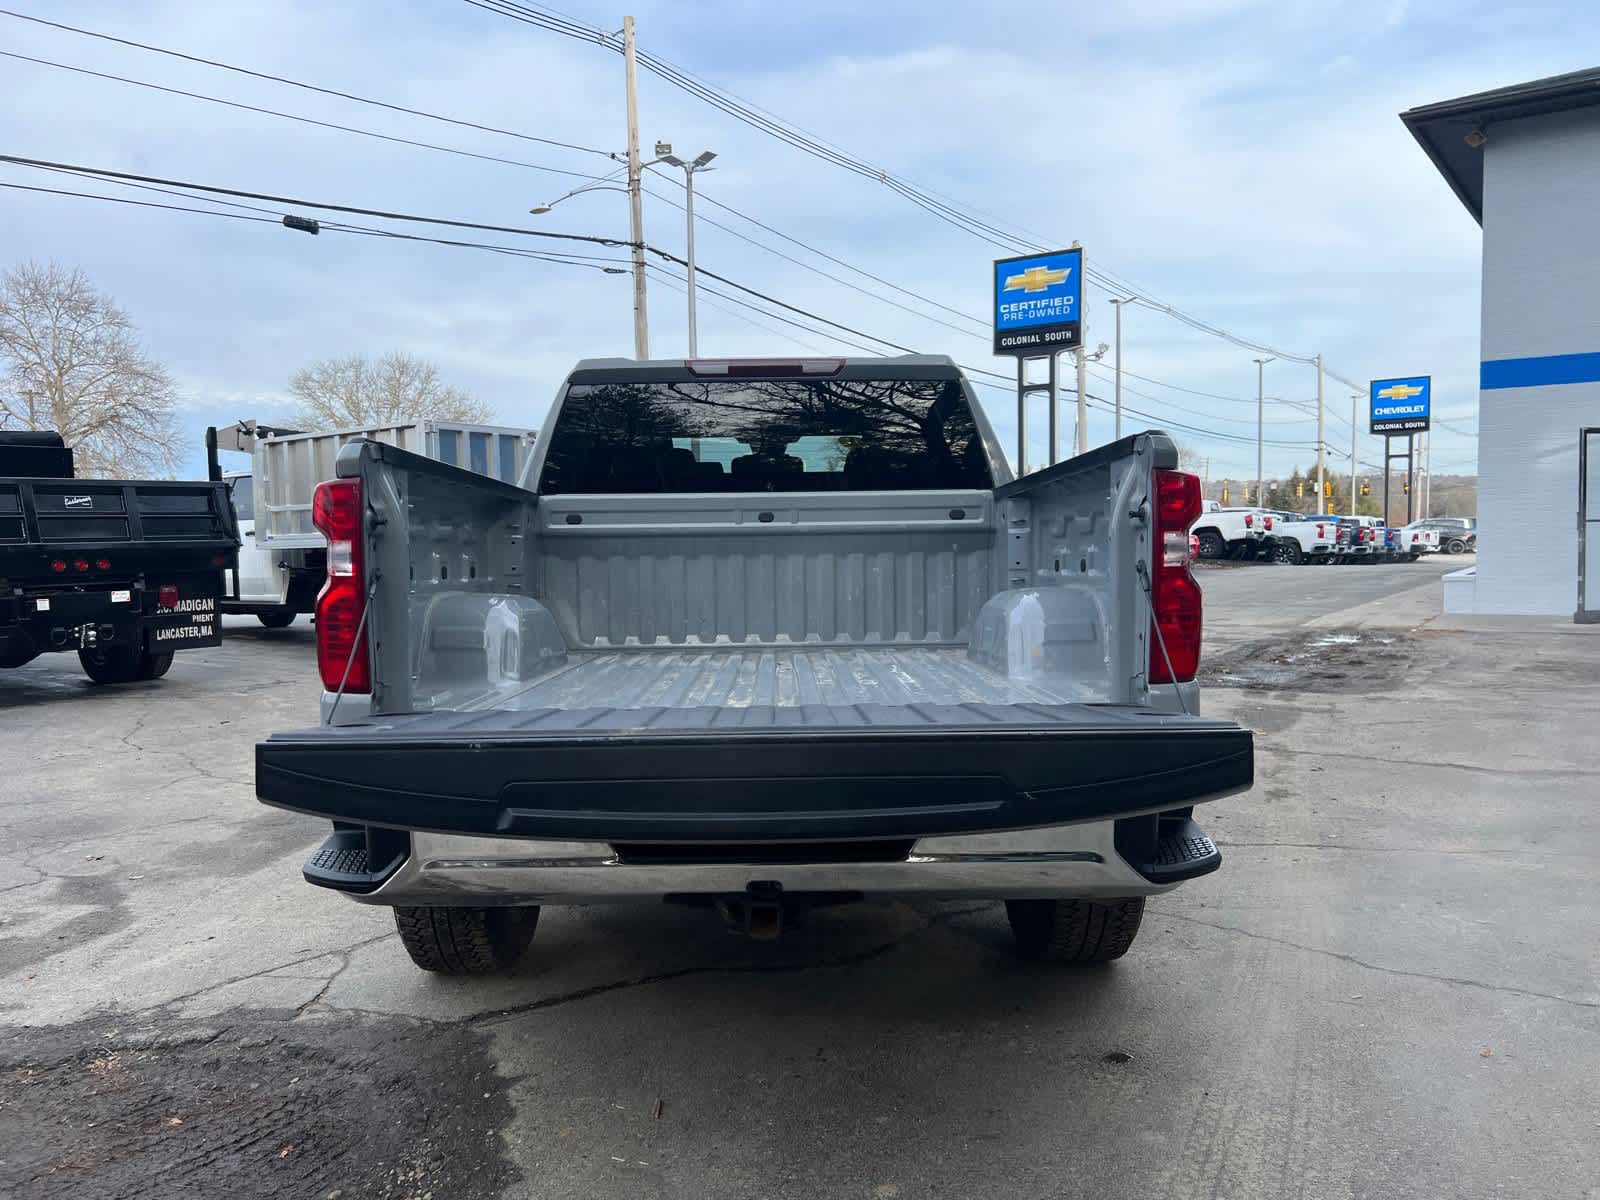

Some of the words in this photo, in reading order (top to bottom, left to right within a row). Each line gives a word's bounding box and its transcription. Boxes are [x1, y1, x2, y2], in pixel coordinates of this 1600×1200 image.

[1000, 296, 1074, 313] CERTIFIED
[1003, 306, 1070, 321] PRE-OWNED
[1001, 334, 1041, 346] COLONIAL
[1045, 331, 1072, 342] SOUTH
[1375, 405, 1425, 415] CHEVROLET
[174, 599, 214, 612] MADIGAN
